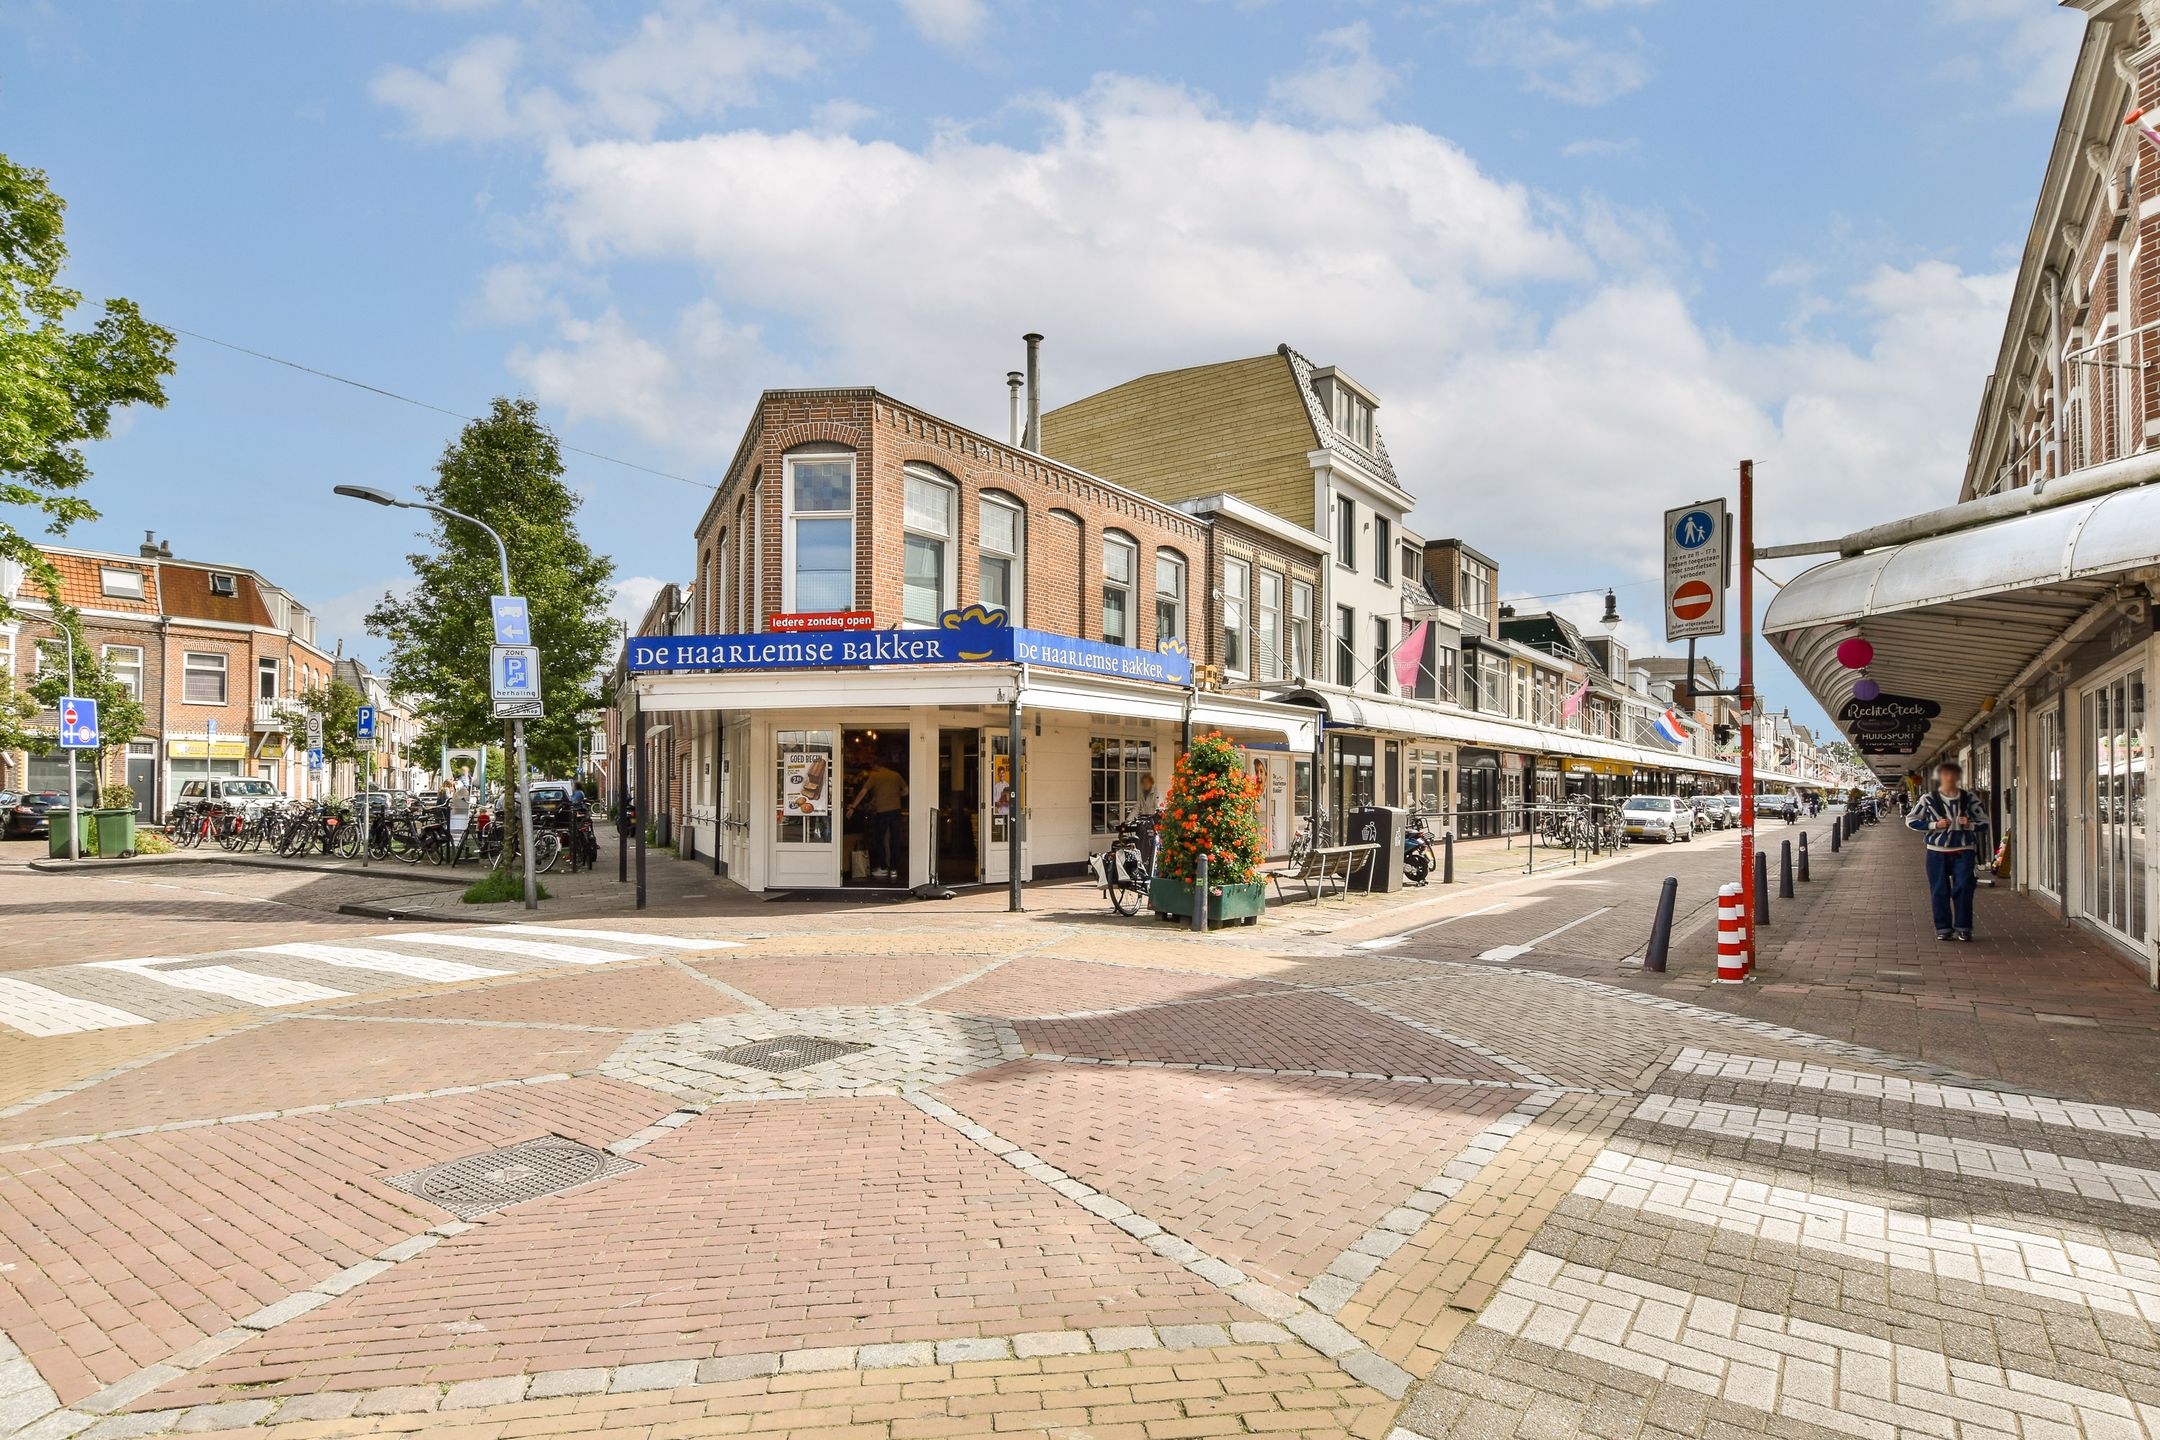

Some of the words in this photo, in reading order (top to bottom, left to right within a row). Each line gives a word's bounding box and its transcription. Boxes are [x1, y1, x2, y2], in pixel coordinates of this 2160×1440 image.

[1688, 555, 1720, 565] toegestaan
[1684, 562, 1717, 572] snorfietsen
[1680, 570, 1706, 579] verboden
[772, 617, 804, 627] Iedere
[807, 616, 844, 627] zondag
[846, 616, 872, 627] open
[635, 647, 668, 665] De
[1018, 642, 1038, 660] De
[508, 659, 522, 675] P
[361, 709, 370, 725] P
[790, 754, 805, 763] GOED
